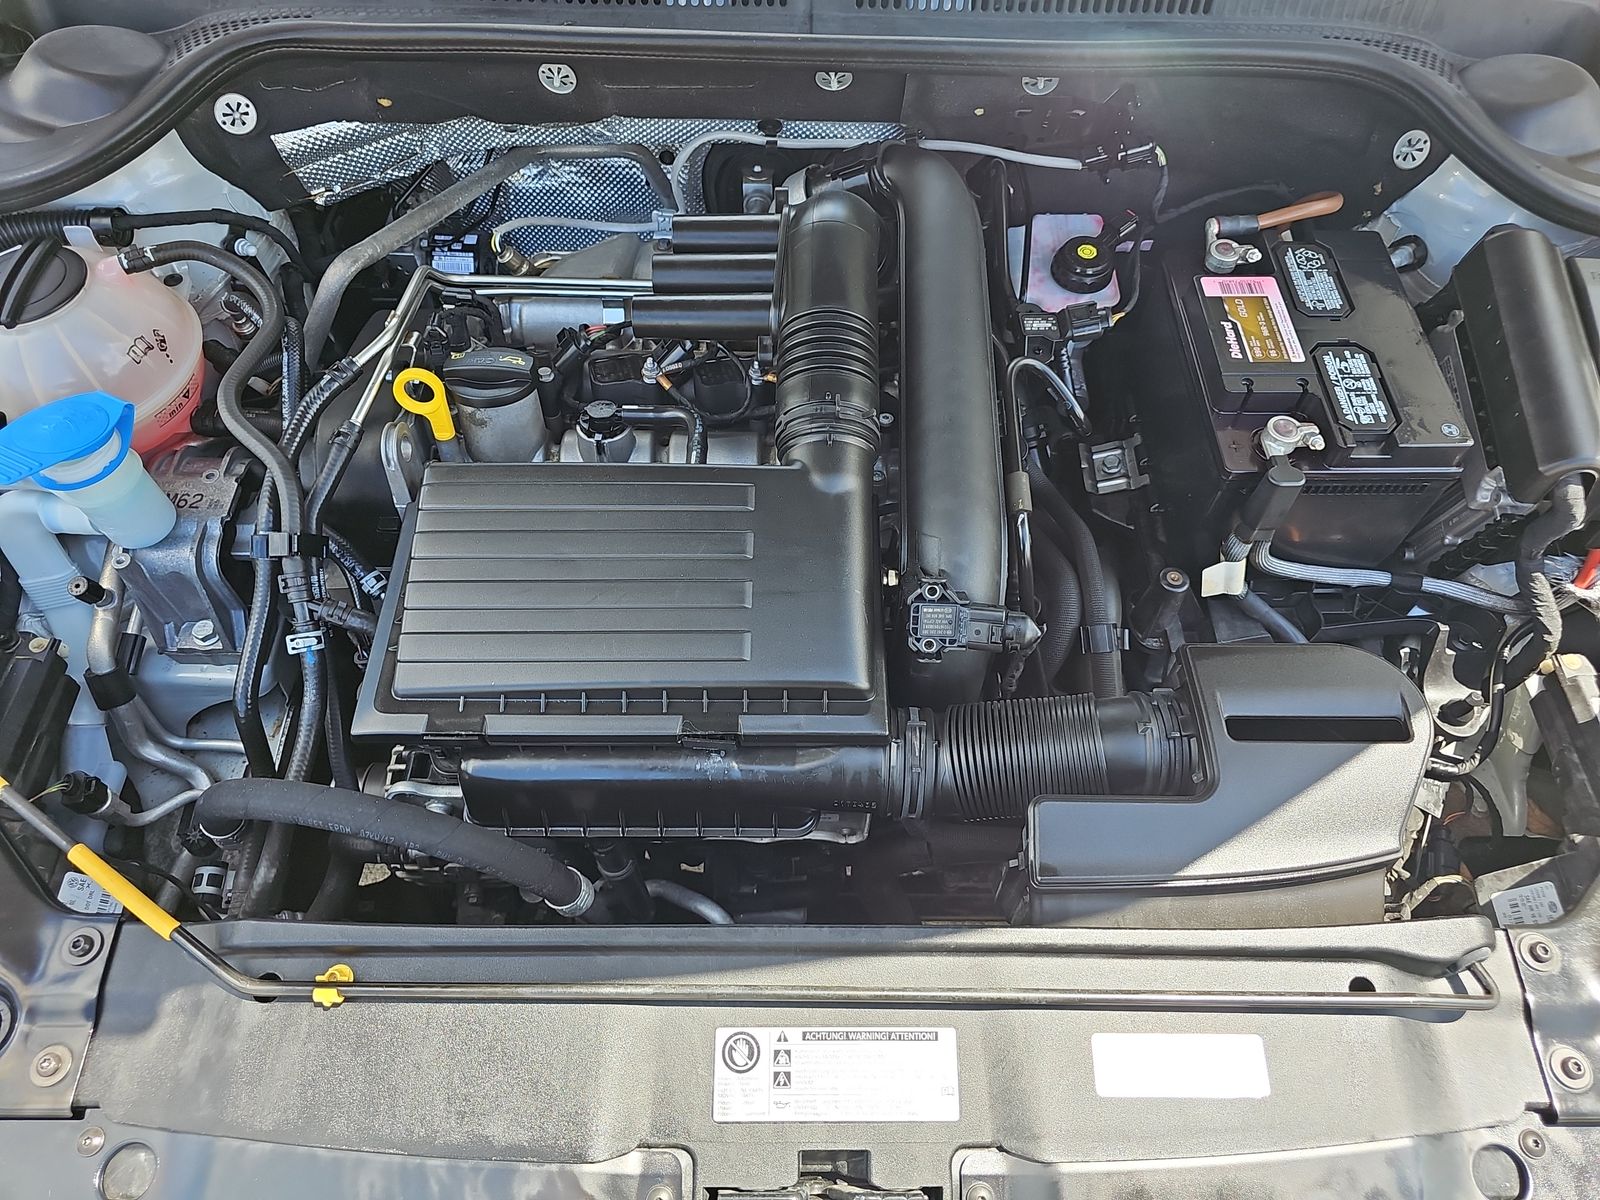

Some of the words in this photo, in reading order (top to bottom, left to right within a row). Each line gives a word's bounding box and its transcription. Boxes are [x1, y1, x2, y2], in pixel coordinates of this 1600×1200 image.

[1234, 298, 1248, 318] GOLD
[1220, 320, 1243, 359] DieHard
[1322, 355, 1338, 380] POISON
[168, 402, 184, 418] min
[1334, 386, 1351, 414] DANGER
[77, 878, 87, 891] SAE
[805, 1031, 847, 1041] ACHTUNG!
[848, 1031, 889, 1041] WARNING!
[891, 1031, 936, 1041] ATTENTION!
